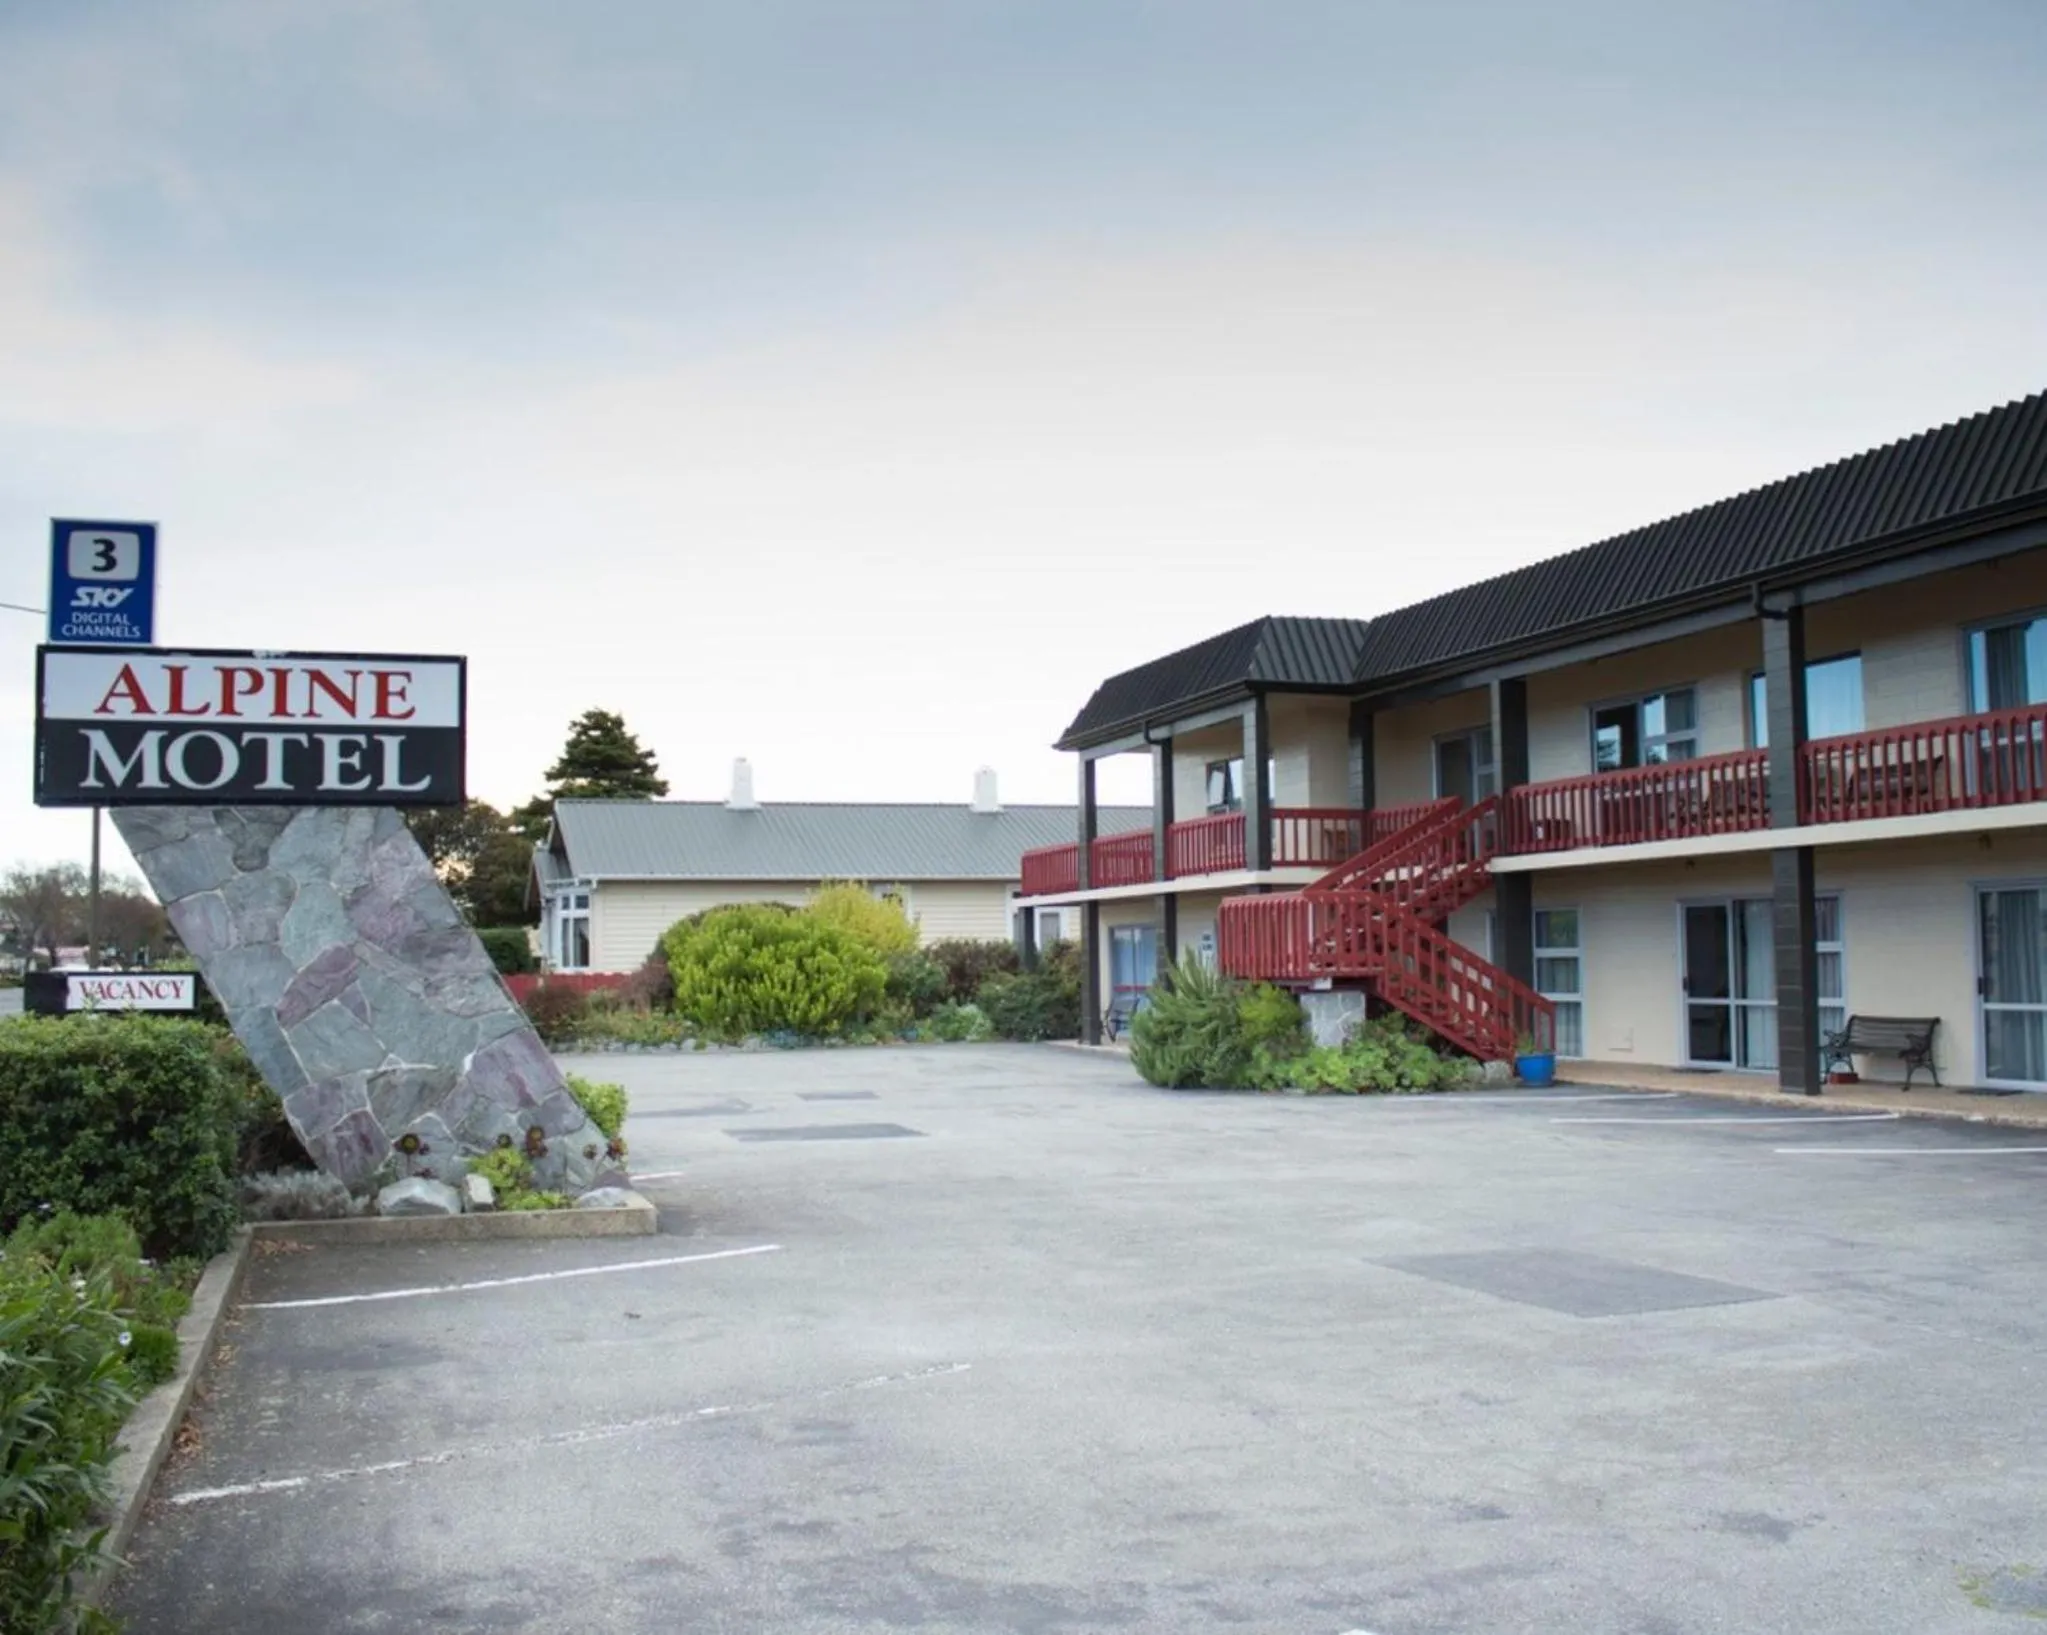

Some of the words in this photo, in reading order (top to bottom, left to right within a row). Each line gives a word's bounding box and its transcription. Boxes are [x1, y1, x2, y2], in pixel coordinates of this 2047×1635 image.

[91, 538, 117, 573] 3
[70, 586, 136, 609] SKY
[72, 611, 131, 626] DIGITAL
[61, 623, 141, 639] CHANNELS
[93, 663, 416, 720] ALPINE
[78, 729, 432, 793] MOTEL
[79, 979, 185, 1000] VACANCY
